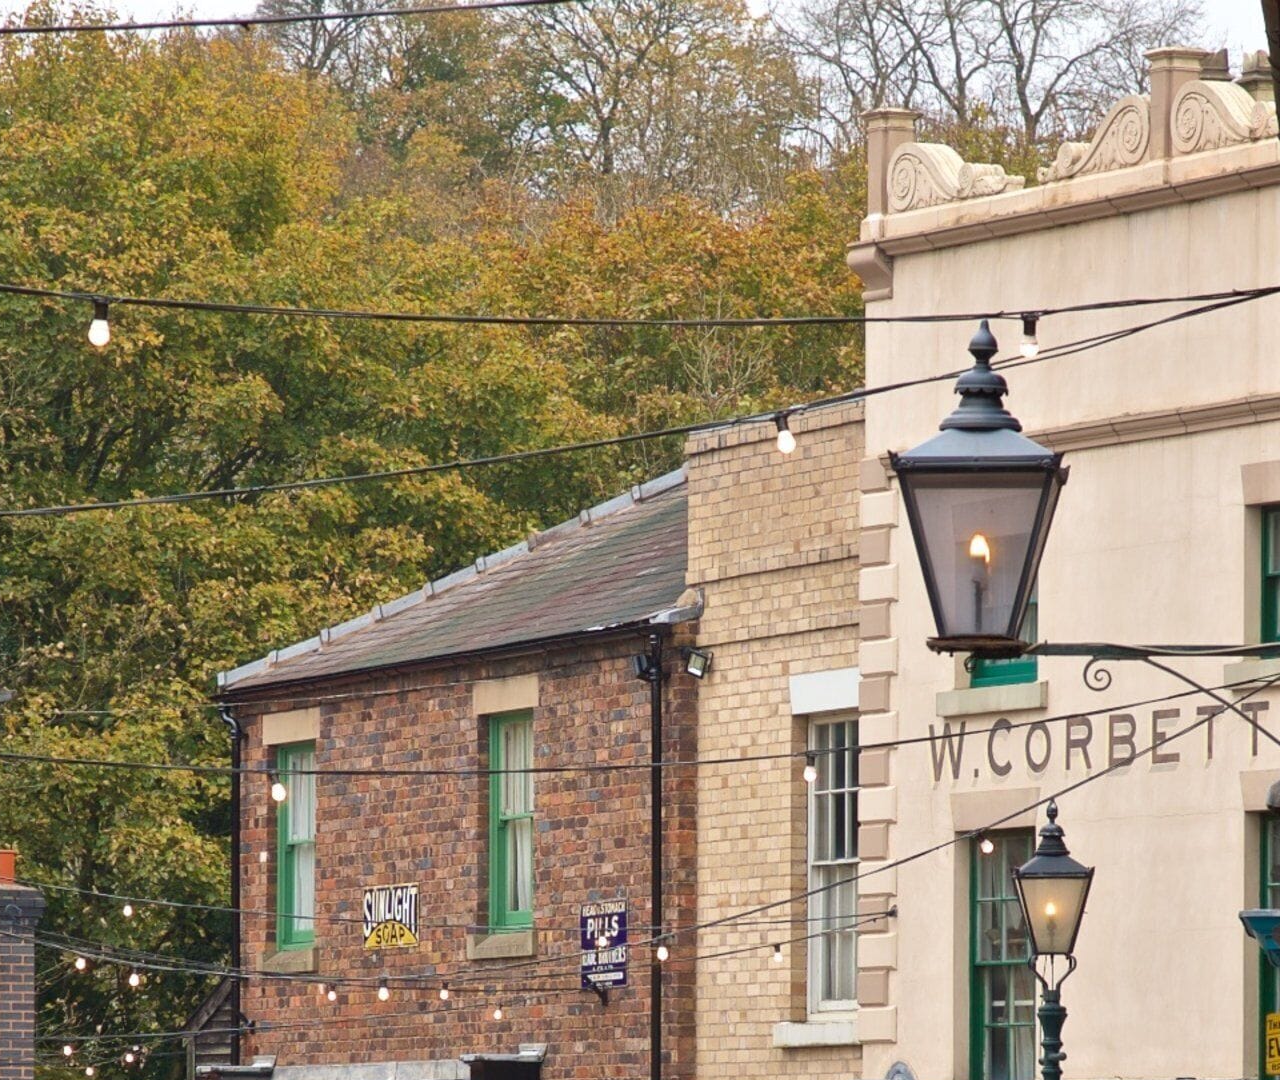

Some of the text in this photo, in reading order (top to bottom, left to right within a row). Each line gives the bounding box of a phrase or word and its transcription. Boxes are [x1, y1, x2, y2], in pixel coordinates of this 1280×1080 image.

[363, 887, 418, 938] SUNLIGHT
[375, 923, 405, 945] SOAP
[586, 915, 619, 939] PILLS
[1268, 1018, 1280, 1031] THE
